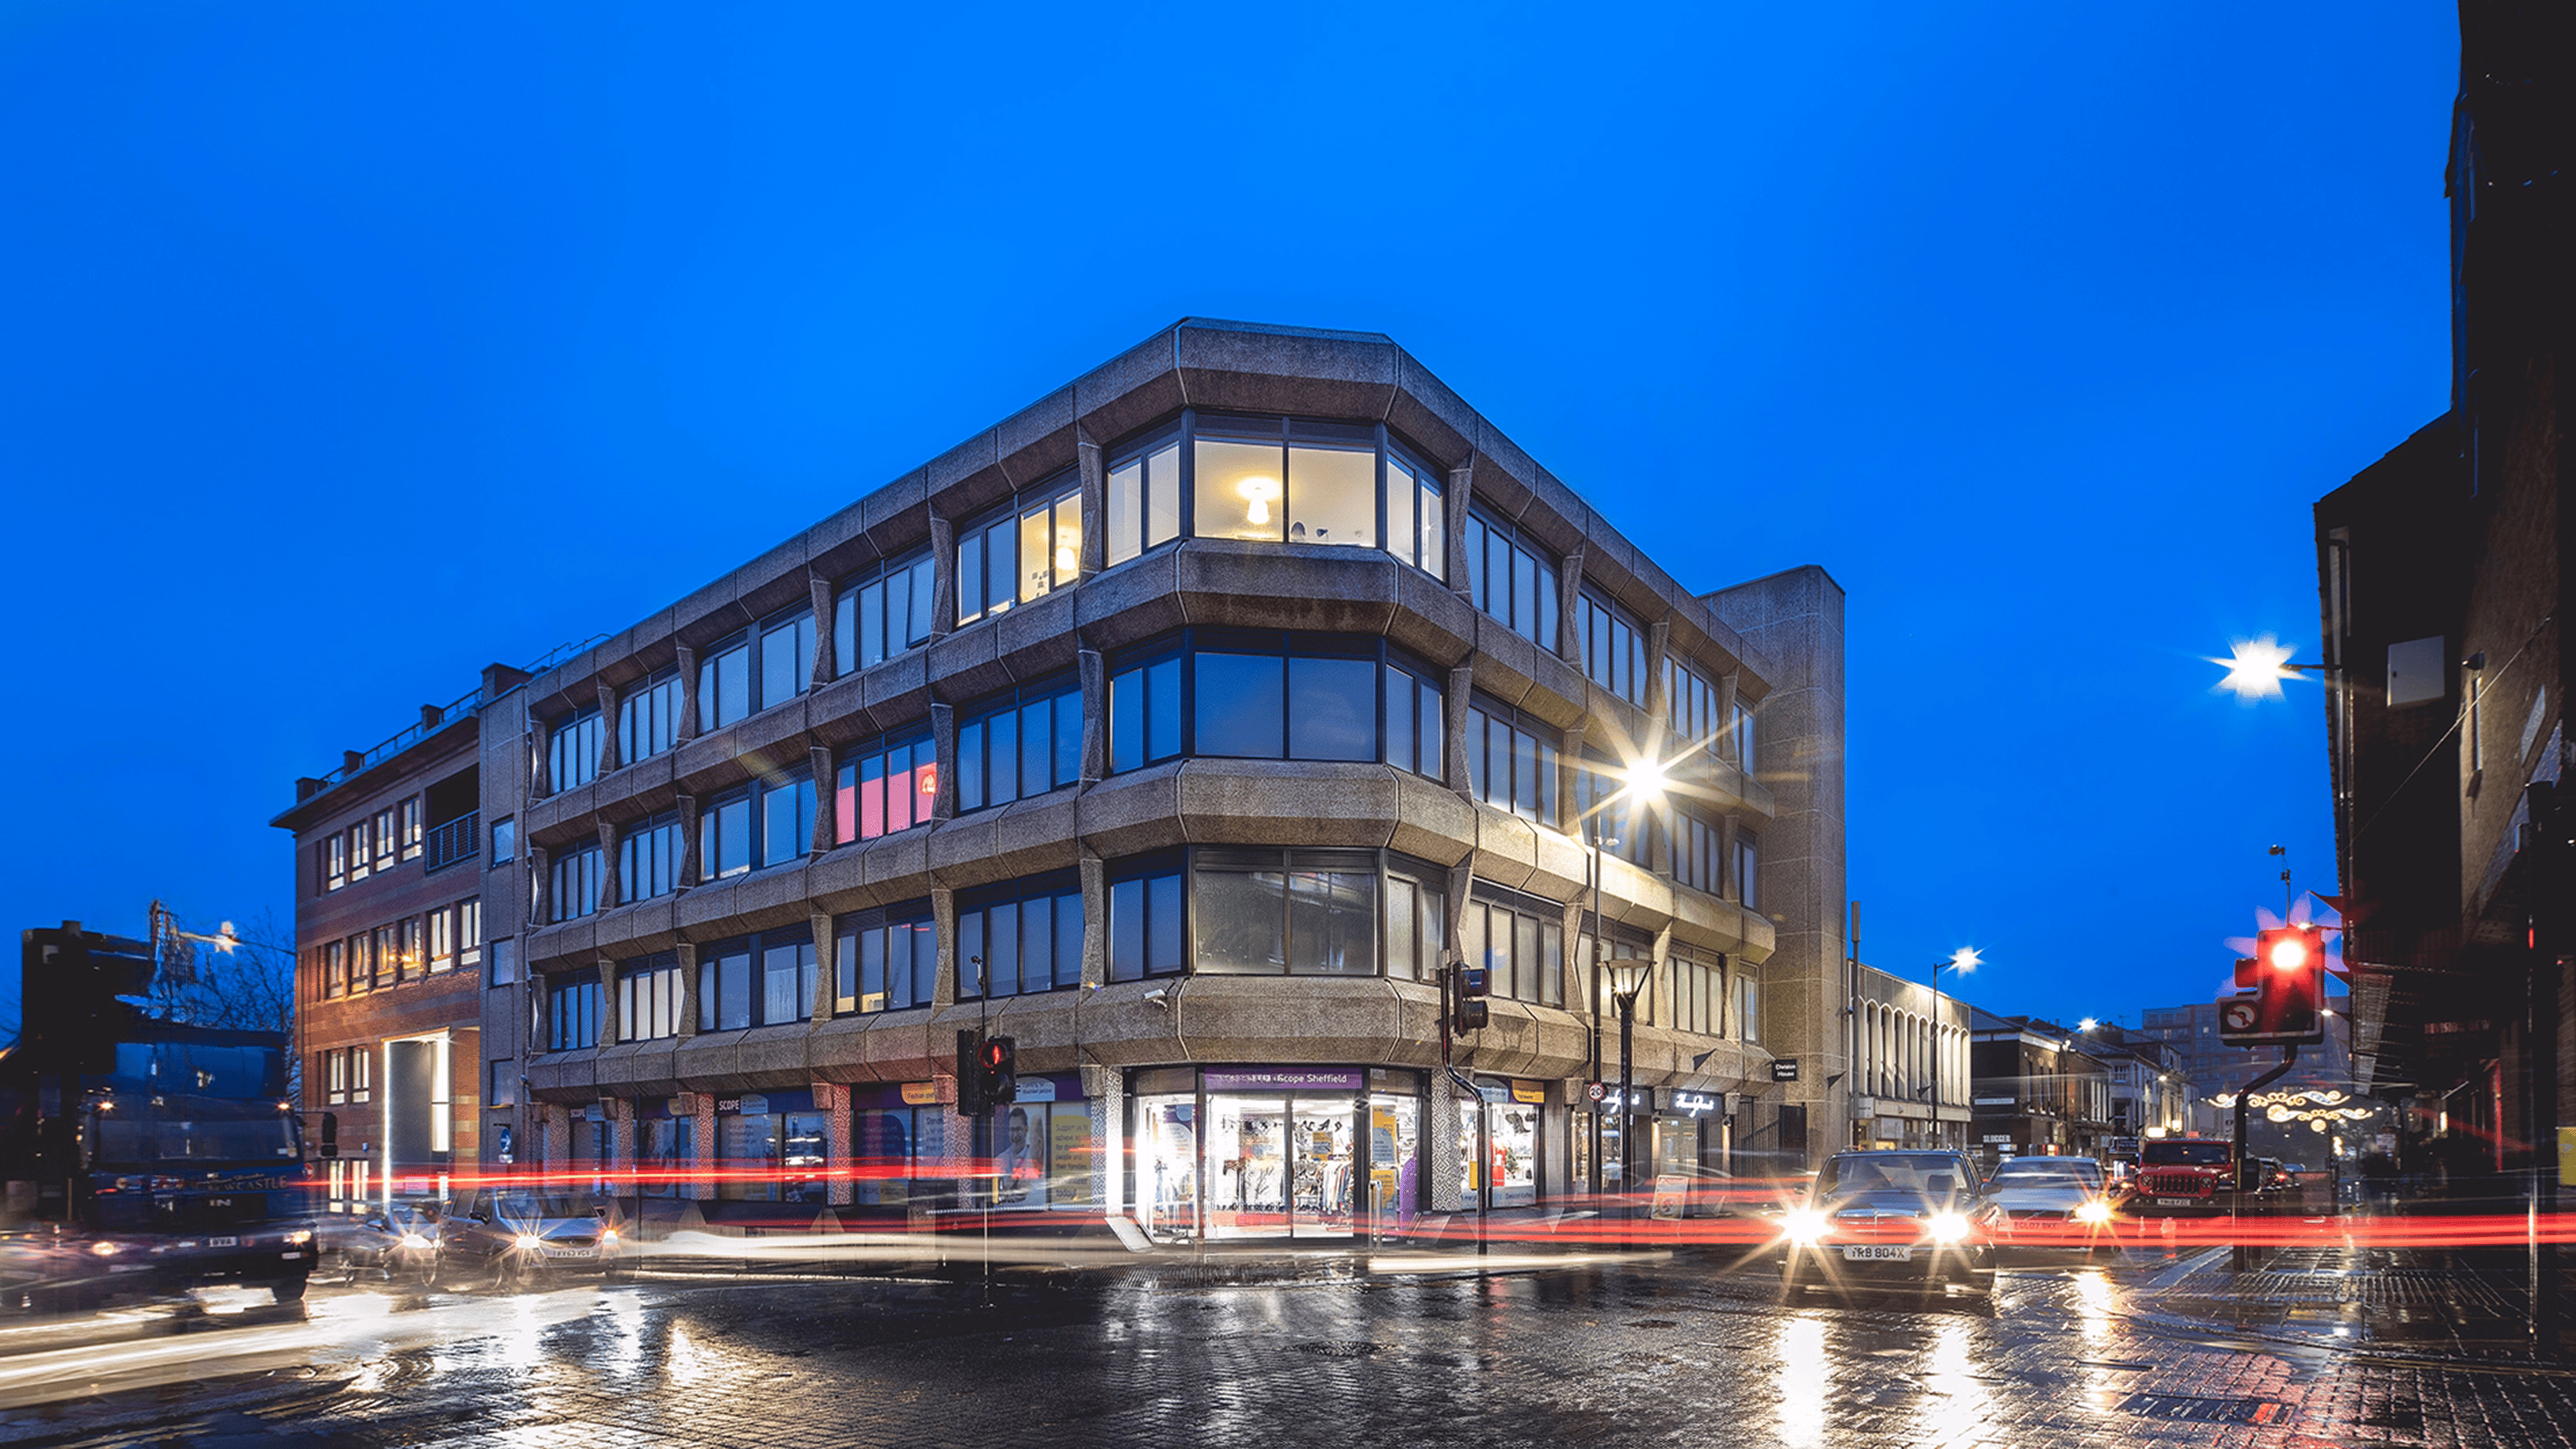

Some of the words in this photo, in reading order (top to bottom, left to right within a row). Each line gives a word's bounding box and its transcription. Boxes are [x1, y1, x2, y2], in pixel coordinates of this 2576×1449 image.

[1306, 1074, 1348, 1084] Sheffield
[1590, 1087, 1601, 1096] 20
[719, 1099, 740, 1111] SCOPE
[570, 1108, 586, 1118] SCOPE
[1983, 1134, 2011, 1143] SLUGGER
[1874, 1248, 1904, 1258] 804X
